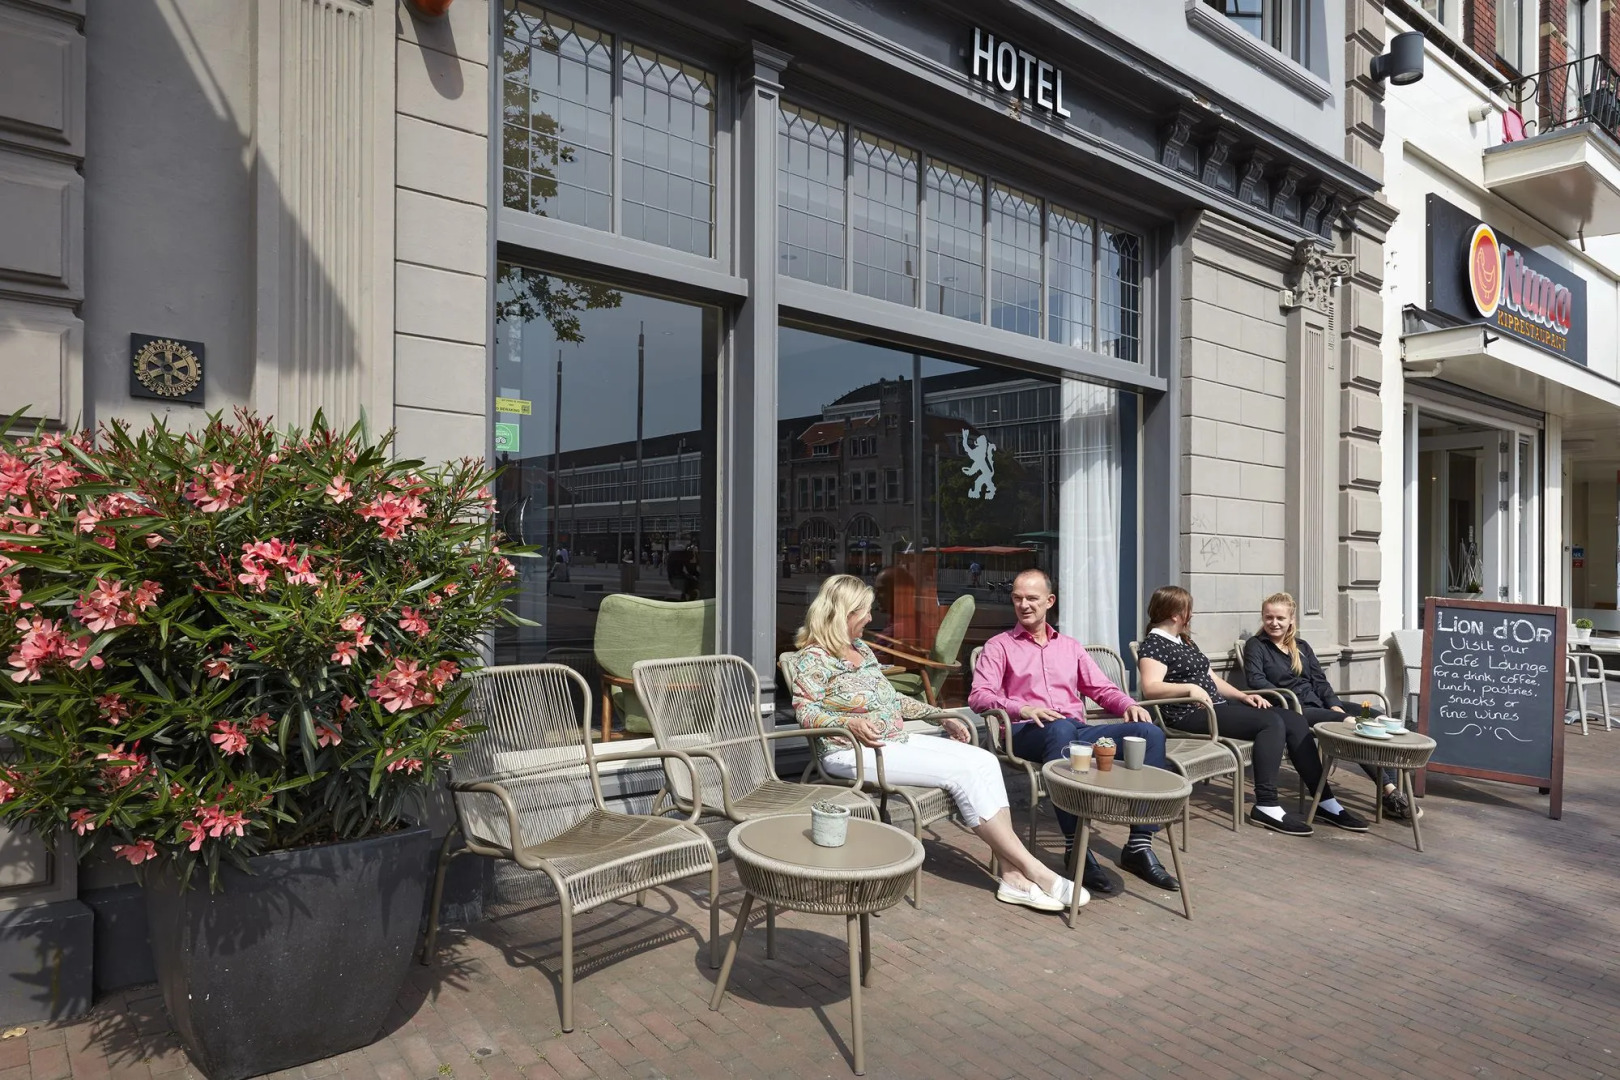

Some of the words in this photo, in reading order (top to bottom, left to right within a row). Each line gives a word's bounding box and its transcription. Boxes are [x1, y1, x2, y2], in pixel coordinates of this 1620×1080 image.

[973, 26, 1071, 118] HOTEL
[1500, 243, 1572, 334] Nuna
[1497, 309, 1567, 352] KIPRESTAURANT
[153, 344, 185, 354] ROTARY
[1450, 637, 1495, 651] Visit
[1501, 645, 1529, 654] our
[1440, 650, 1480, 667] Café
[1489, 655, 1549, 677] Lounge
[1463, 670, 1495, 682] drink,
[1448, 695, 1495, 706] snacks
